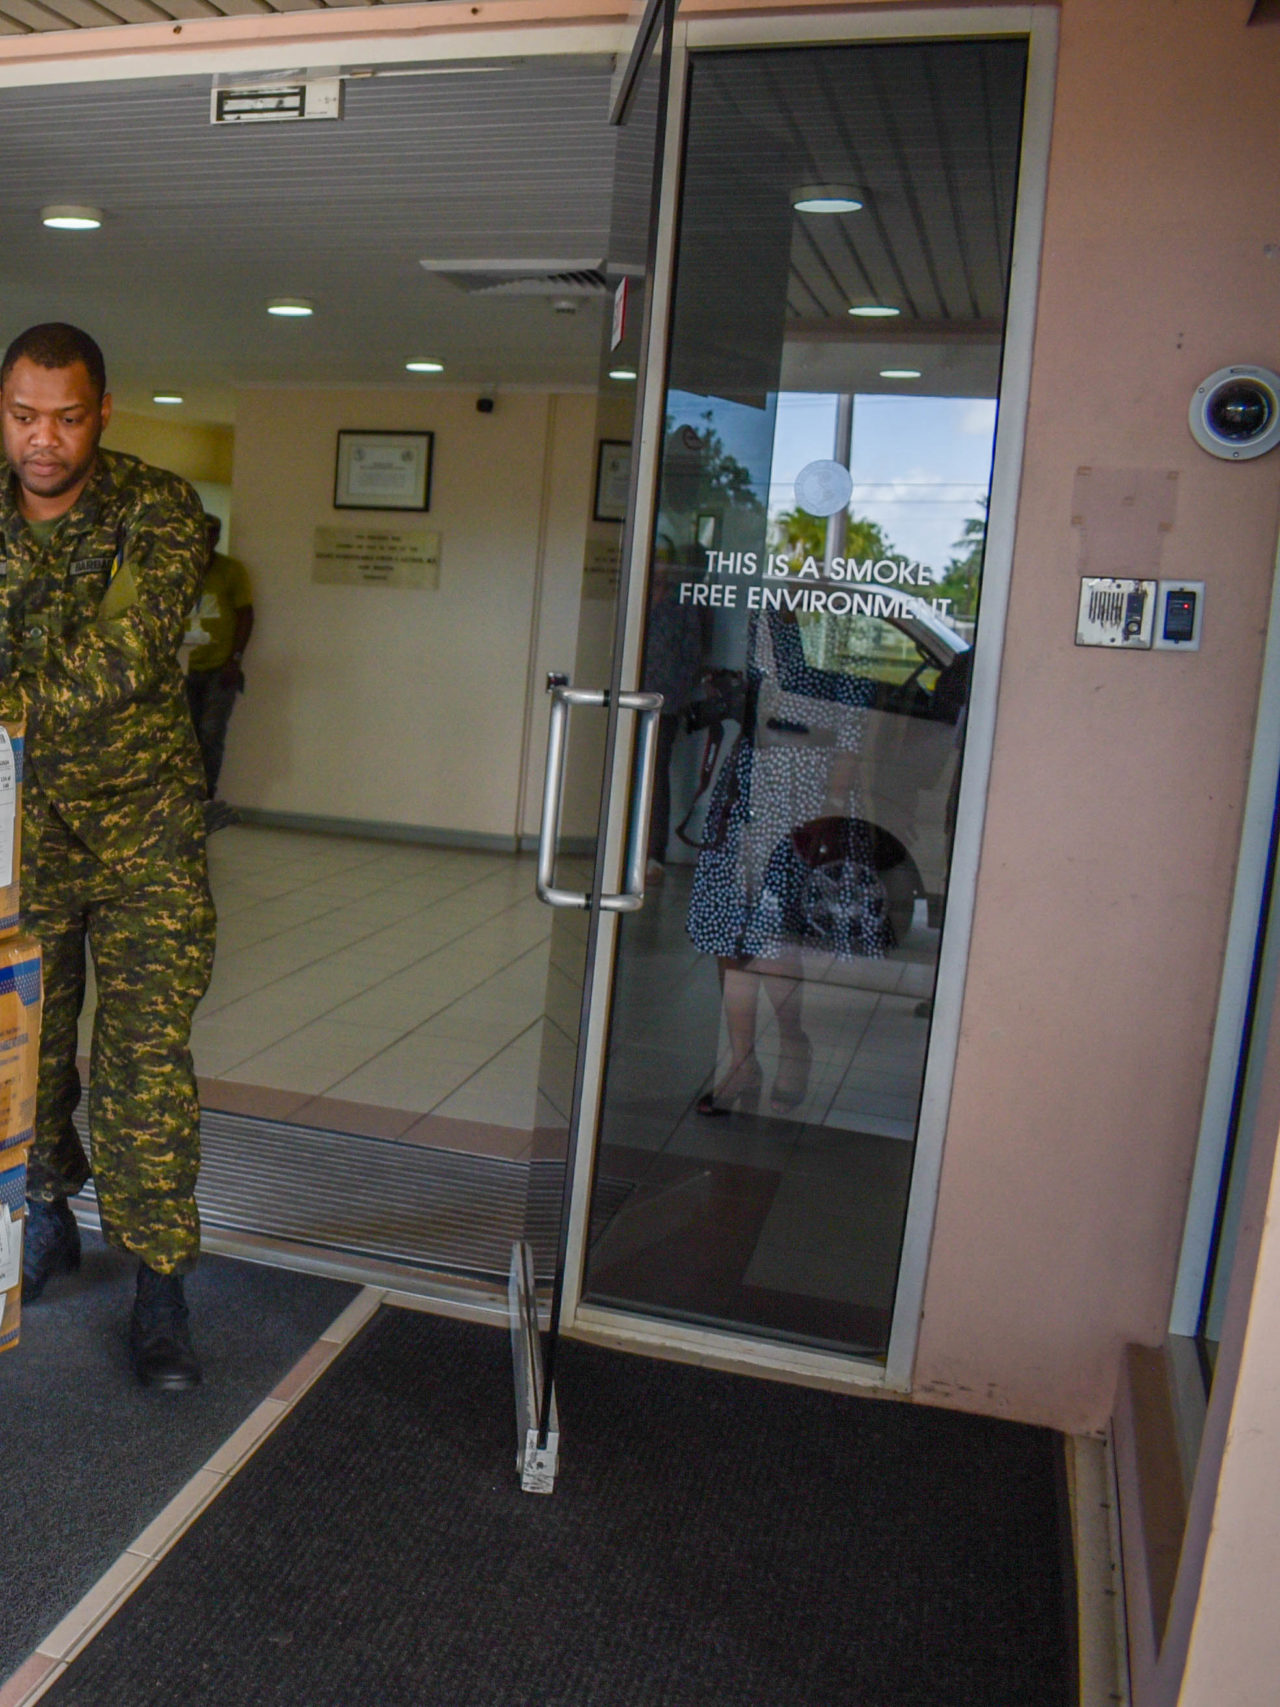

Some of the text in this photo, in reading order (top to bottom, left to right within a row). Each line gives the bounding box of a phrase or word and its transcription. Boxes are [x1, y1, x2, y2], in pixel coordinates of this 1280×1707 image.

[705, 551, 932, 587] THIS IS A SMOKE
[678, 582, 736, 608] FREE
